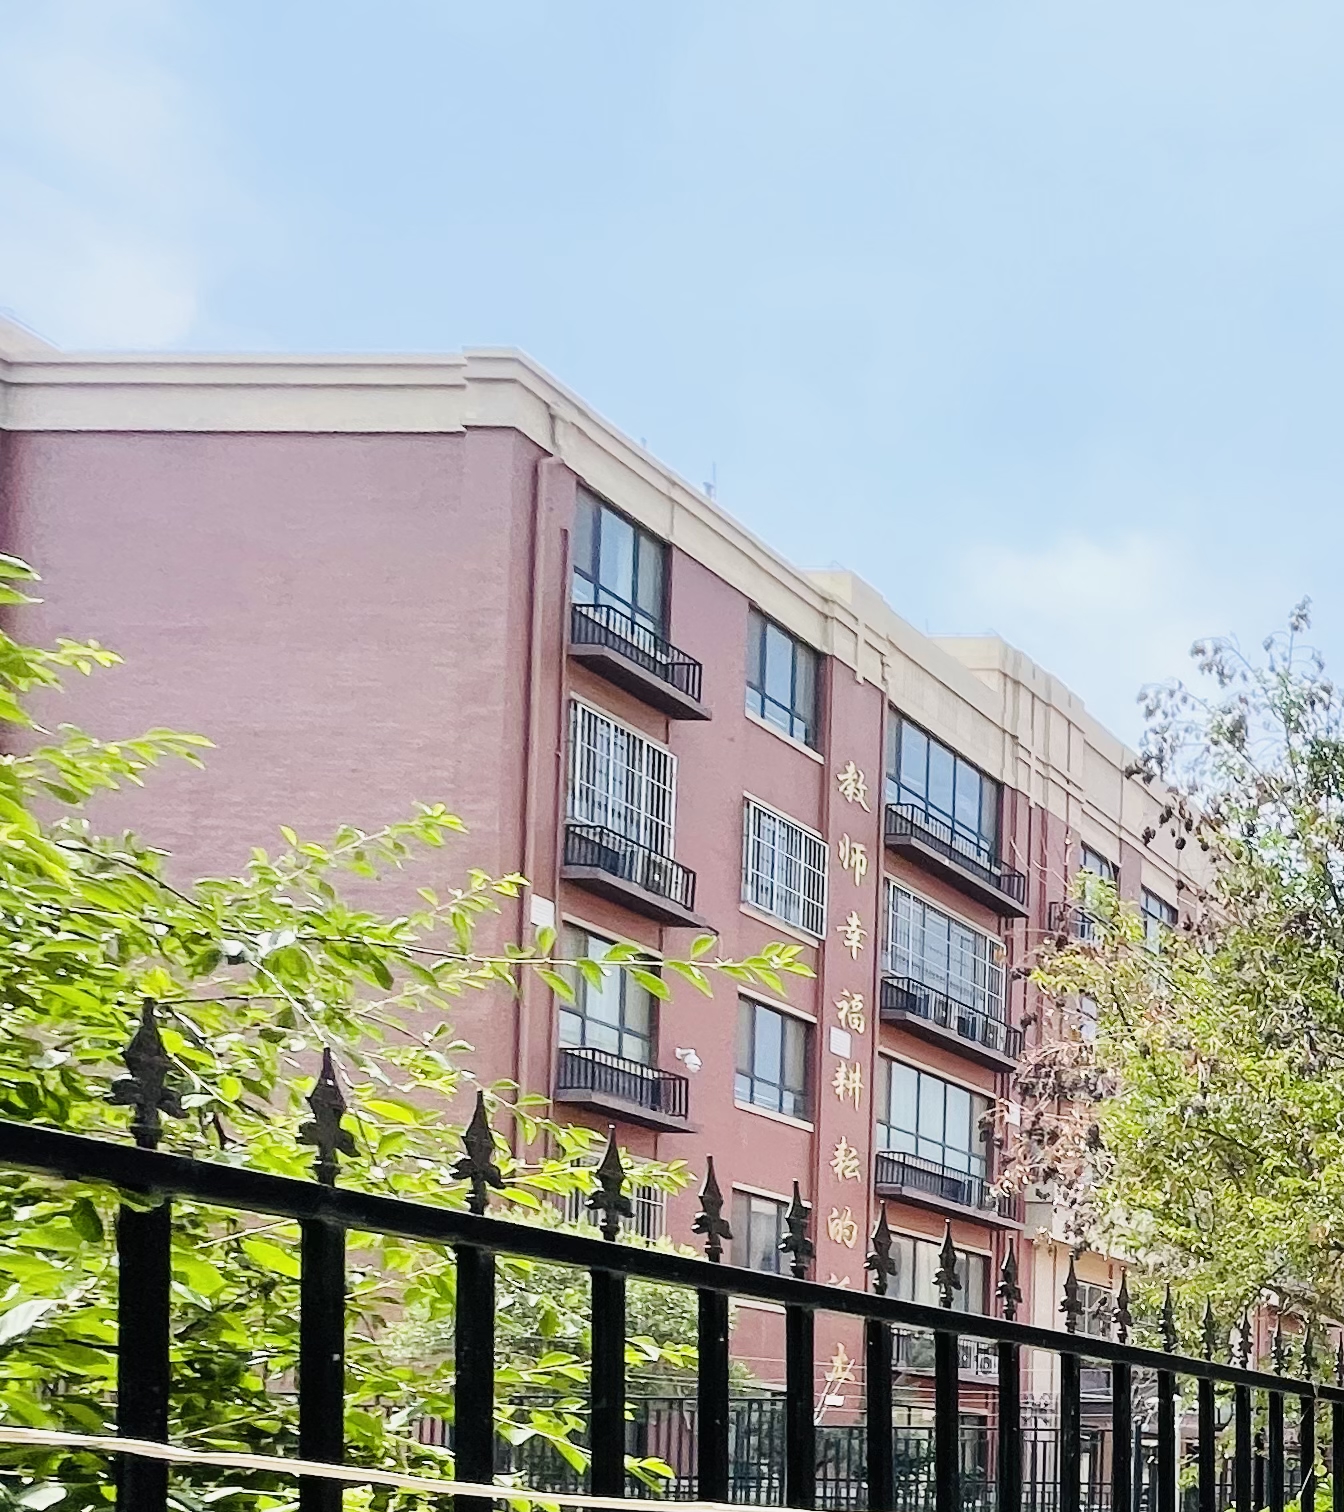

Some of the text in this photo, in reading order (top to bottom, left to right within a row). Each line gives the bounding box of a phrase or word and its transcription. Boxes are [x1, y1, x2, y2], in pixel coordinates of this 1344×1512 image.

[825, 760, 871, 1383] 教师幸福耕耘的土
